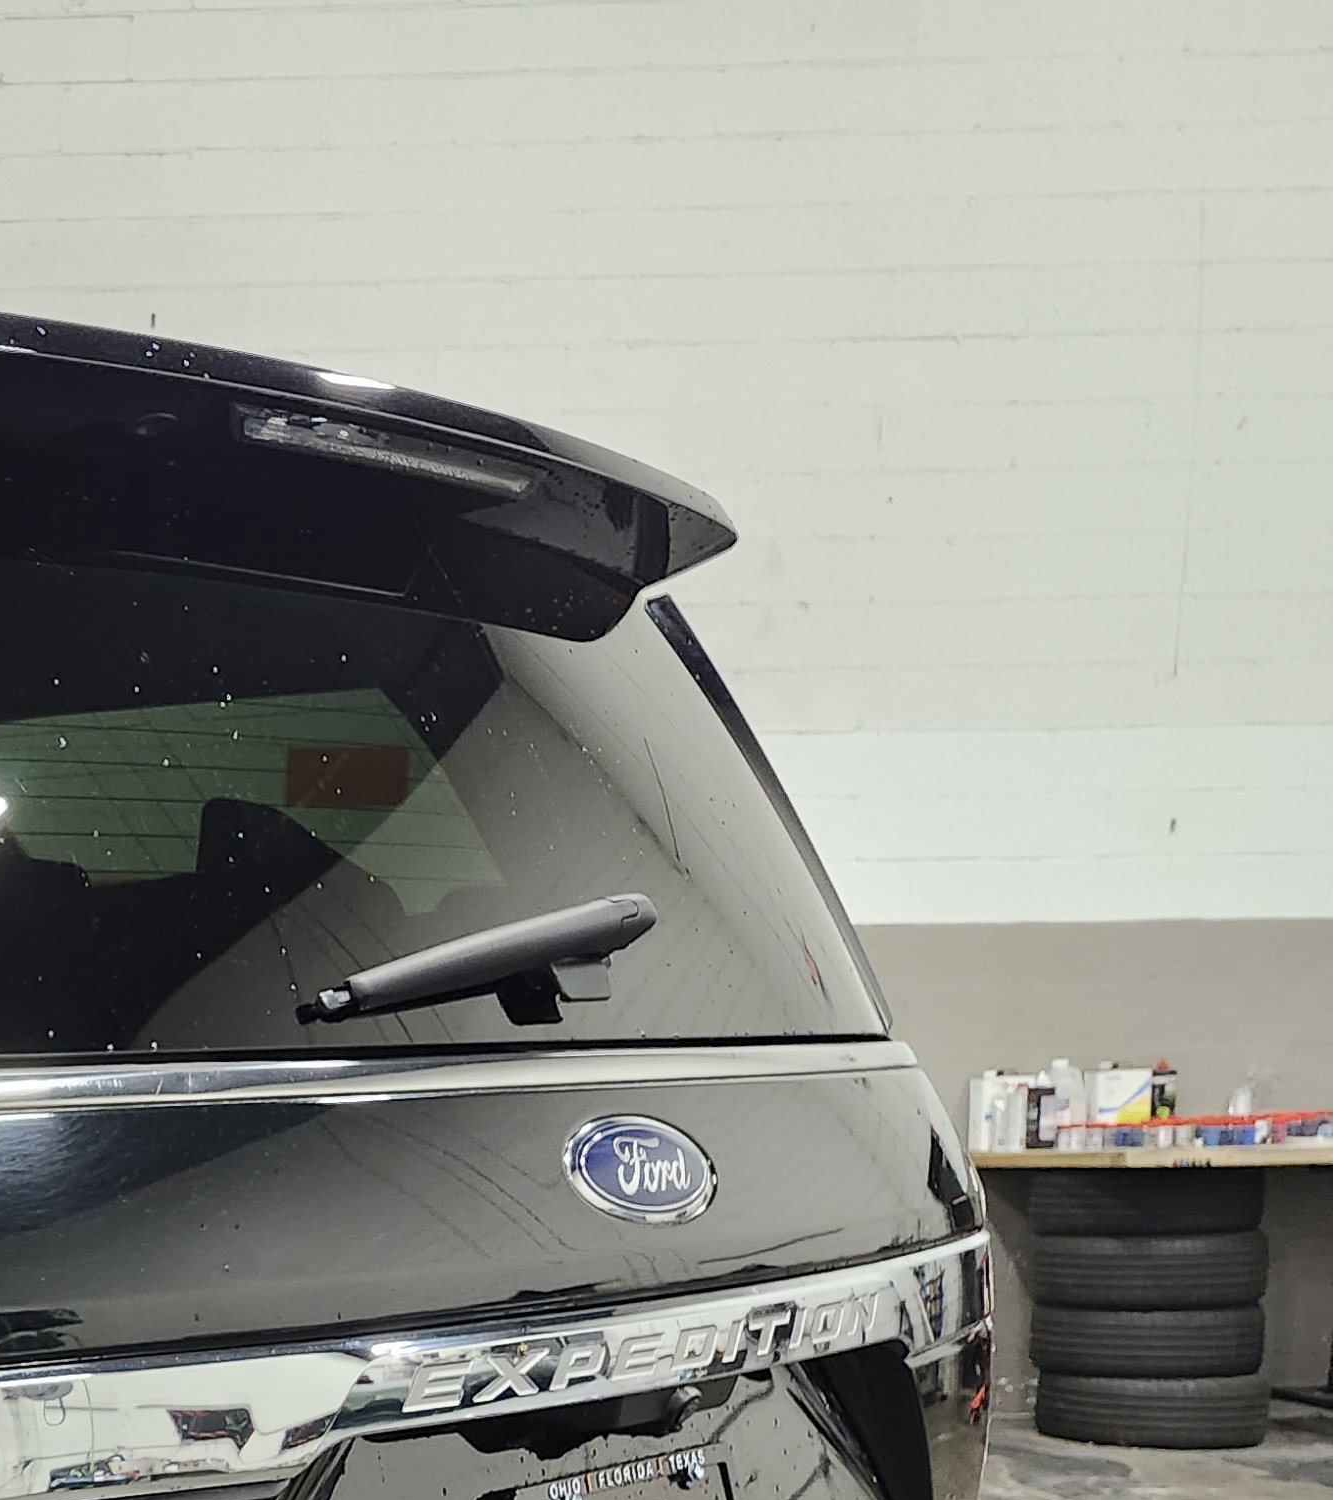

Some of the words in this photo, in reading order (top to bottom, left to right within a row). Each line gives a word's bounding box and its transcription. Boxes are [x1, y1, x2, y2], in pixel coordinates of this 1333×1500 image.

[613, 1137, 691, 1196] Ford
[401, 1292, 883, 1414] EXPEDITION
[548, 1477, 581, 1500] OHIO
[597, 1461, 654, 1489] FLORIDA
[666, 1449, 706, 1473] TEXAS
